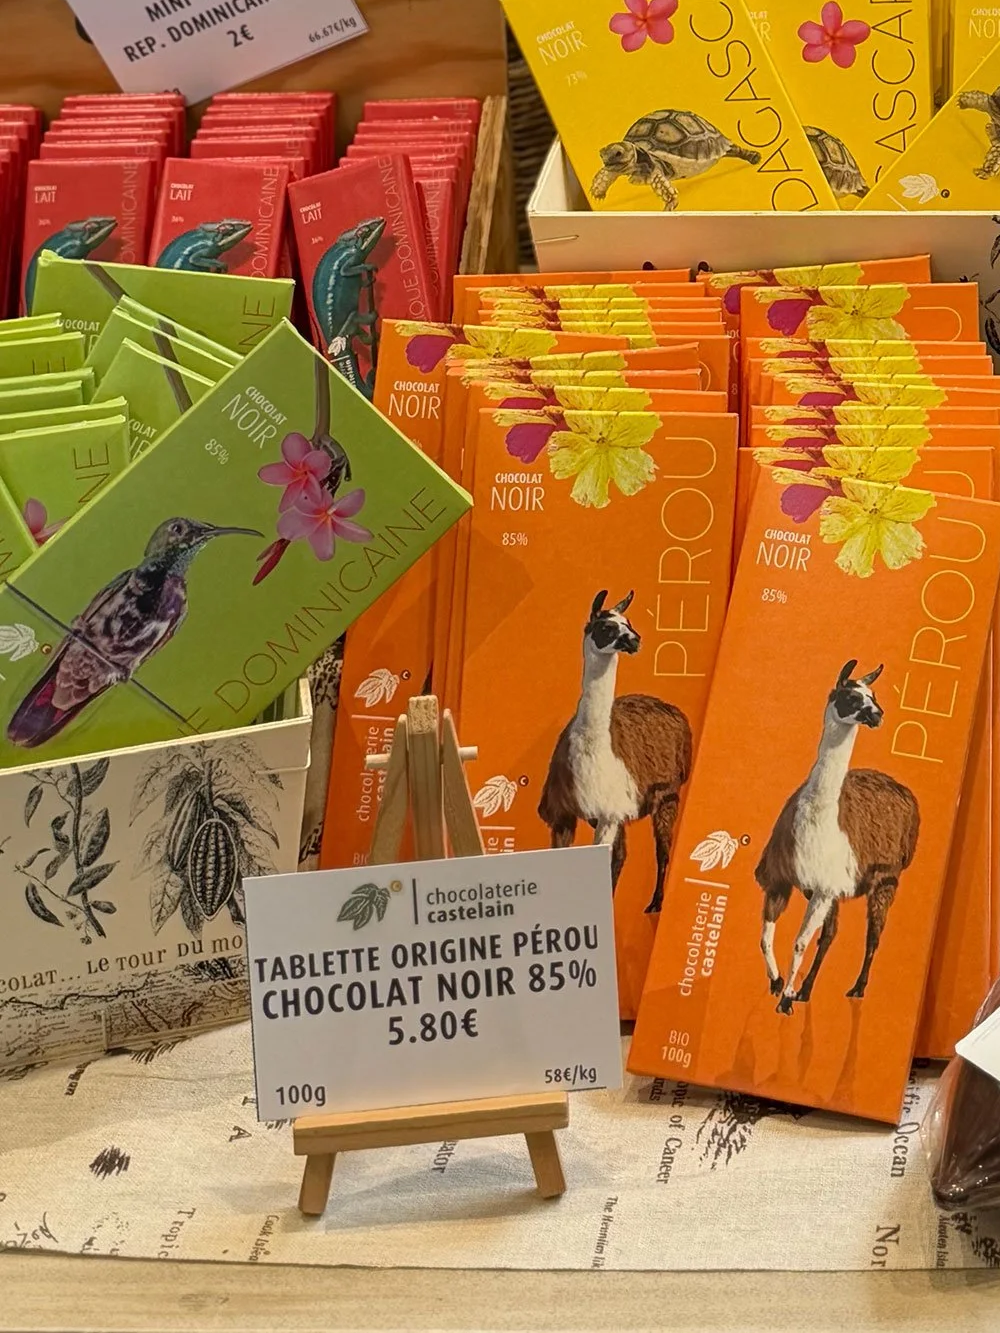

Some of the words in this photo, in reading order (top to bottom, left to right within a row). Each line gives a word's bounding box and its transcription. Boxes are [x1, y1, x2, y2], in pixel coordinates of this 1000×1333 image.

[226, 24, 254, 48] 2€
[535, 20, 576, 44] CHOCOLAT
[123, 36, 167, 63] REP.
[537, 30, 588, 66] NOIR
[563, 70, 588, 87] 73%
[34, 191, 56, 204] LAIT
[169, 189, 192, 201] LAIT
[301, 208, 323, 226] LAIT
[393, 379, 441, 394] CHOCOLAT
[244, 385, 288, 425] CHOCOLAT
[388, 393, 442, 420] NOIR
[221, 393, 278, 449] NOIR
[204, 438, 229, 466] 85%
[494, 471, 543, 485] CHOCOLAT
[490, 484, 545, 512] NOIR
[501, 531, 528, 547] 85%
[764, 528, 812, 546] CHOCOLAT
[646, 435, 718, 677] PÉROU
[756, 542, 812, 573] NOIR
[214, 486, 447, 714] DOMINICAINE
[761, 588, 788, 603] 85%
[890, 515, 988, 764] PÉROU
[426, 878, 538, 907] chocolaterie
[427, 900, 515, 924] castelain
[678, 890, 714, 998] chocolaterie
[700, 893, 730, 979] castelain
[254, 946, 381, 984] TABLETTE
[391, 933, 503, 968] ORIGINE
[513, 923, 599, 957] PÉROU
[261, 978, 424, 1021] CHOCOLAT
[437, 969, 516, 1005] NOIR
[528, 958, 598, 994] 85%
[387, 1009, 480, 1046] 5.80€
[668, 1028, 690, 1047] BIO
[661, 1045, 693, 1068] 100g
[275, 1084, 328, 1108] 100g
[544, 1064, 598, 1085] 58€/kg
[669, 1113, 686, 1132] of
[870, 1224, 901, 1268] Nor
